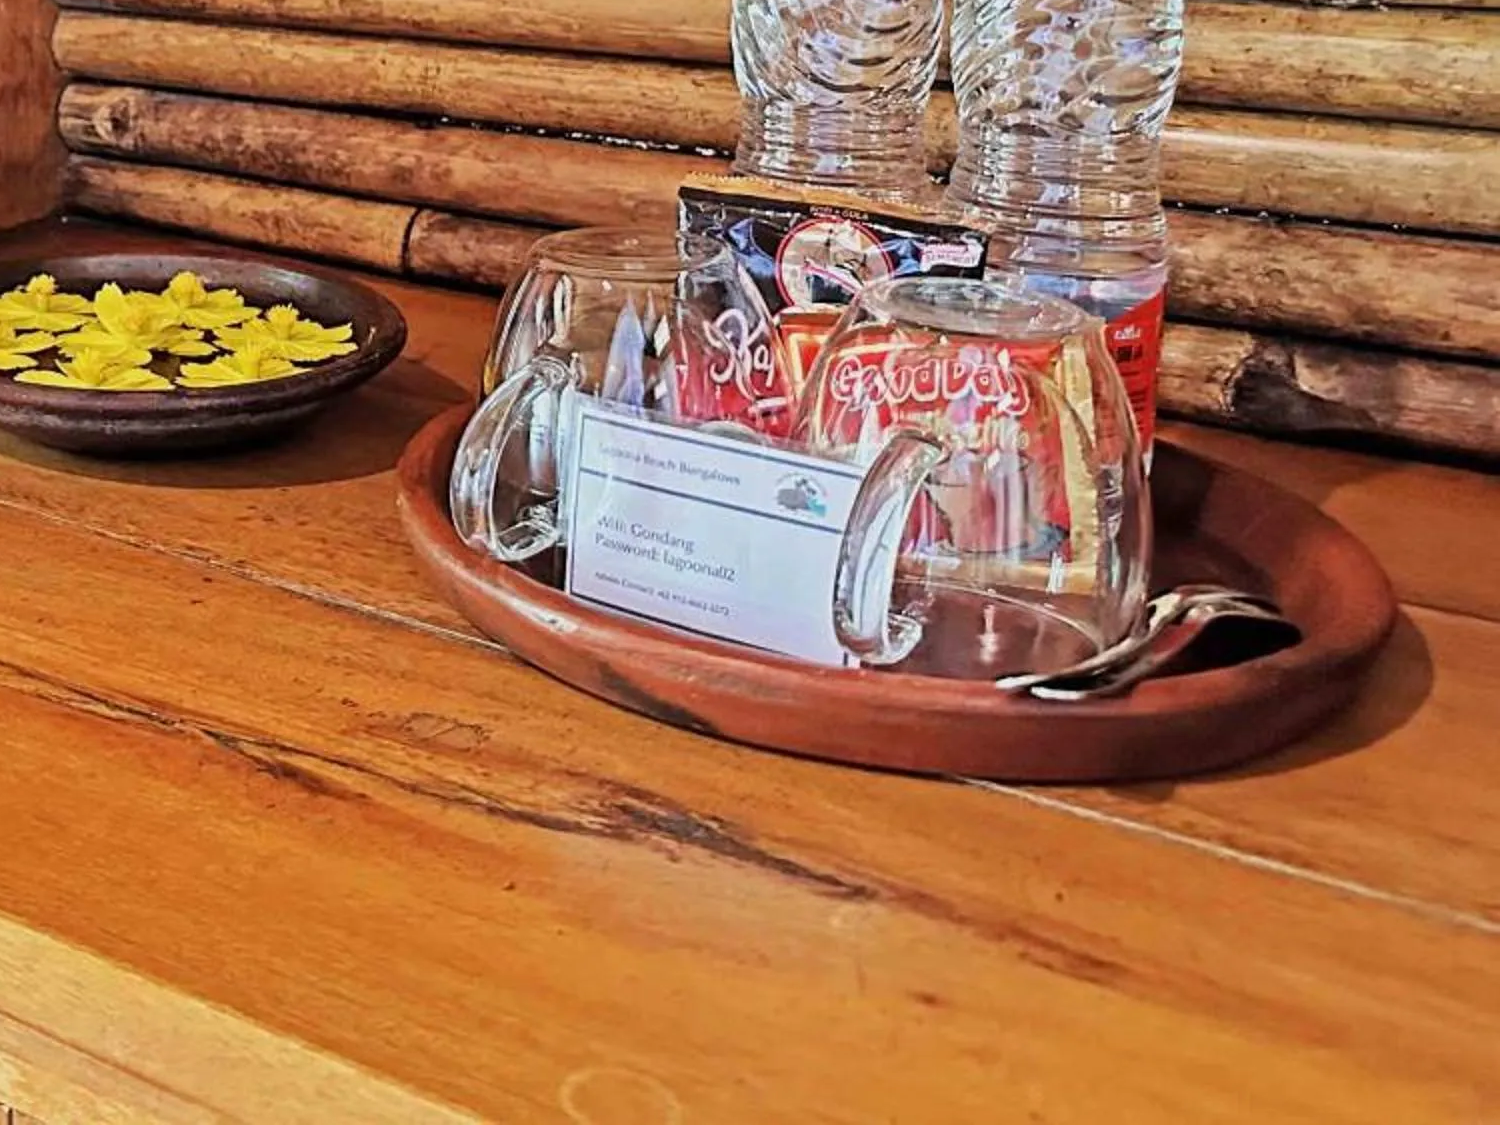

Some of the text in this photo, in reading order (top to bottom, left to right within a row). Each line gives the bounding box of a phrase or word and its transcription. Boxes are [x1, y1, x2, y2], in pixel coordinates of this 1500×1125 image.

[830, 356, 1030, 417] Good Day
[643, 453, 676, 472] Beach
[679, 461, 741, 486] Bungalows
[595, 532, 661, 563] Password:
[630, 523, 696, 555] Gondang
